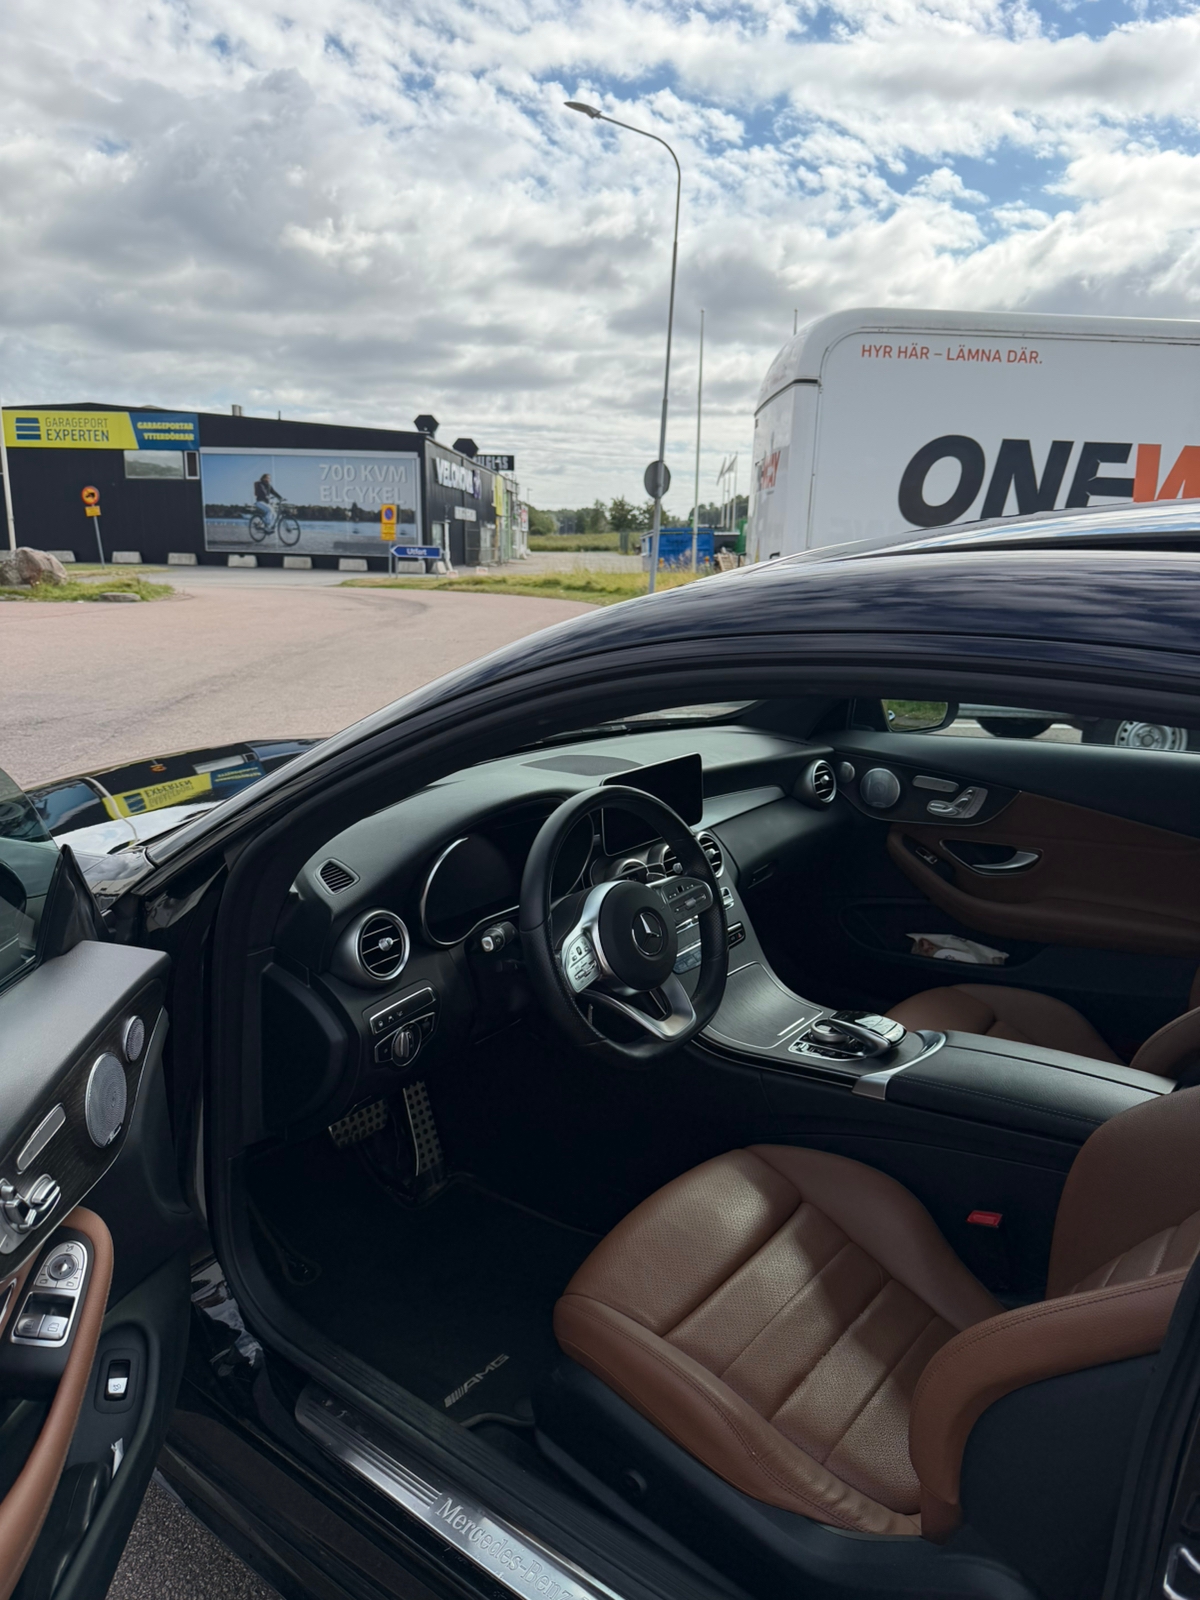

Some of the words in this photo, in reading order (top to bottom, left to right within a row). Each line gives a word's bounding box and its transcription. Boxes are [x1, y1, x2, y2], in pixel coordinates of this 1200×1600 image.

[861, 343, 893, 359] HYR
[897, 343, 930, 361] HÄR
[946, 345, 1002, 363] LÄMNA
[1006, 347, 1043, 365] DÄR.
[45, 417, 109, 429] GARAGEPORT
[46, 429, 110, 442] EXPERTEN
[319, 464, 356, 481] 700
[361, 465, 408, 483] KVM
[319, 485, 407, 504] ELCYKEL
